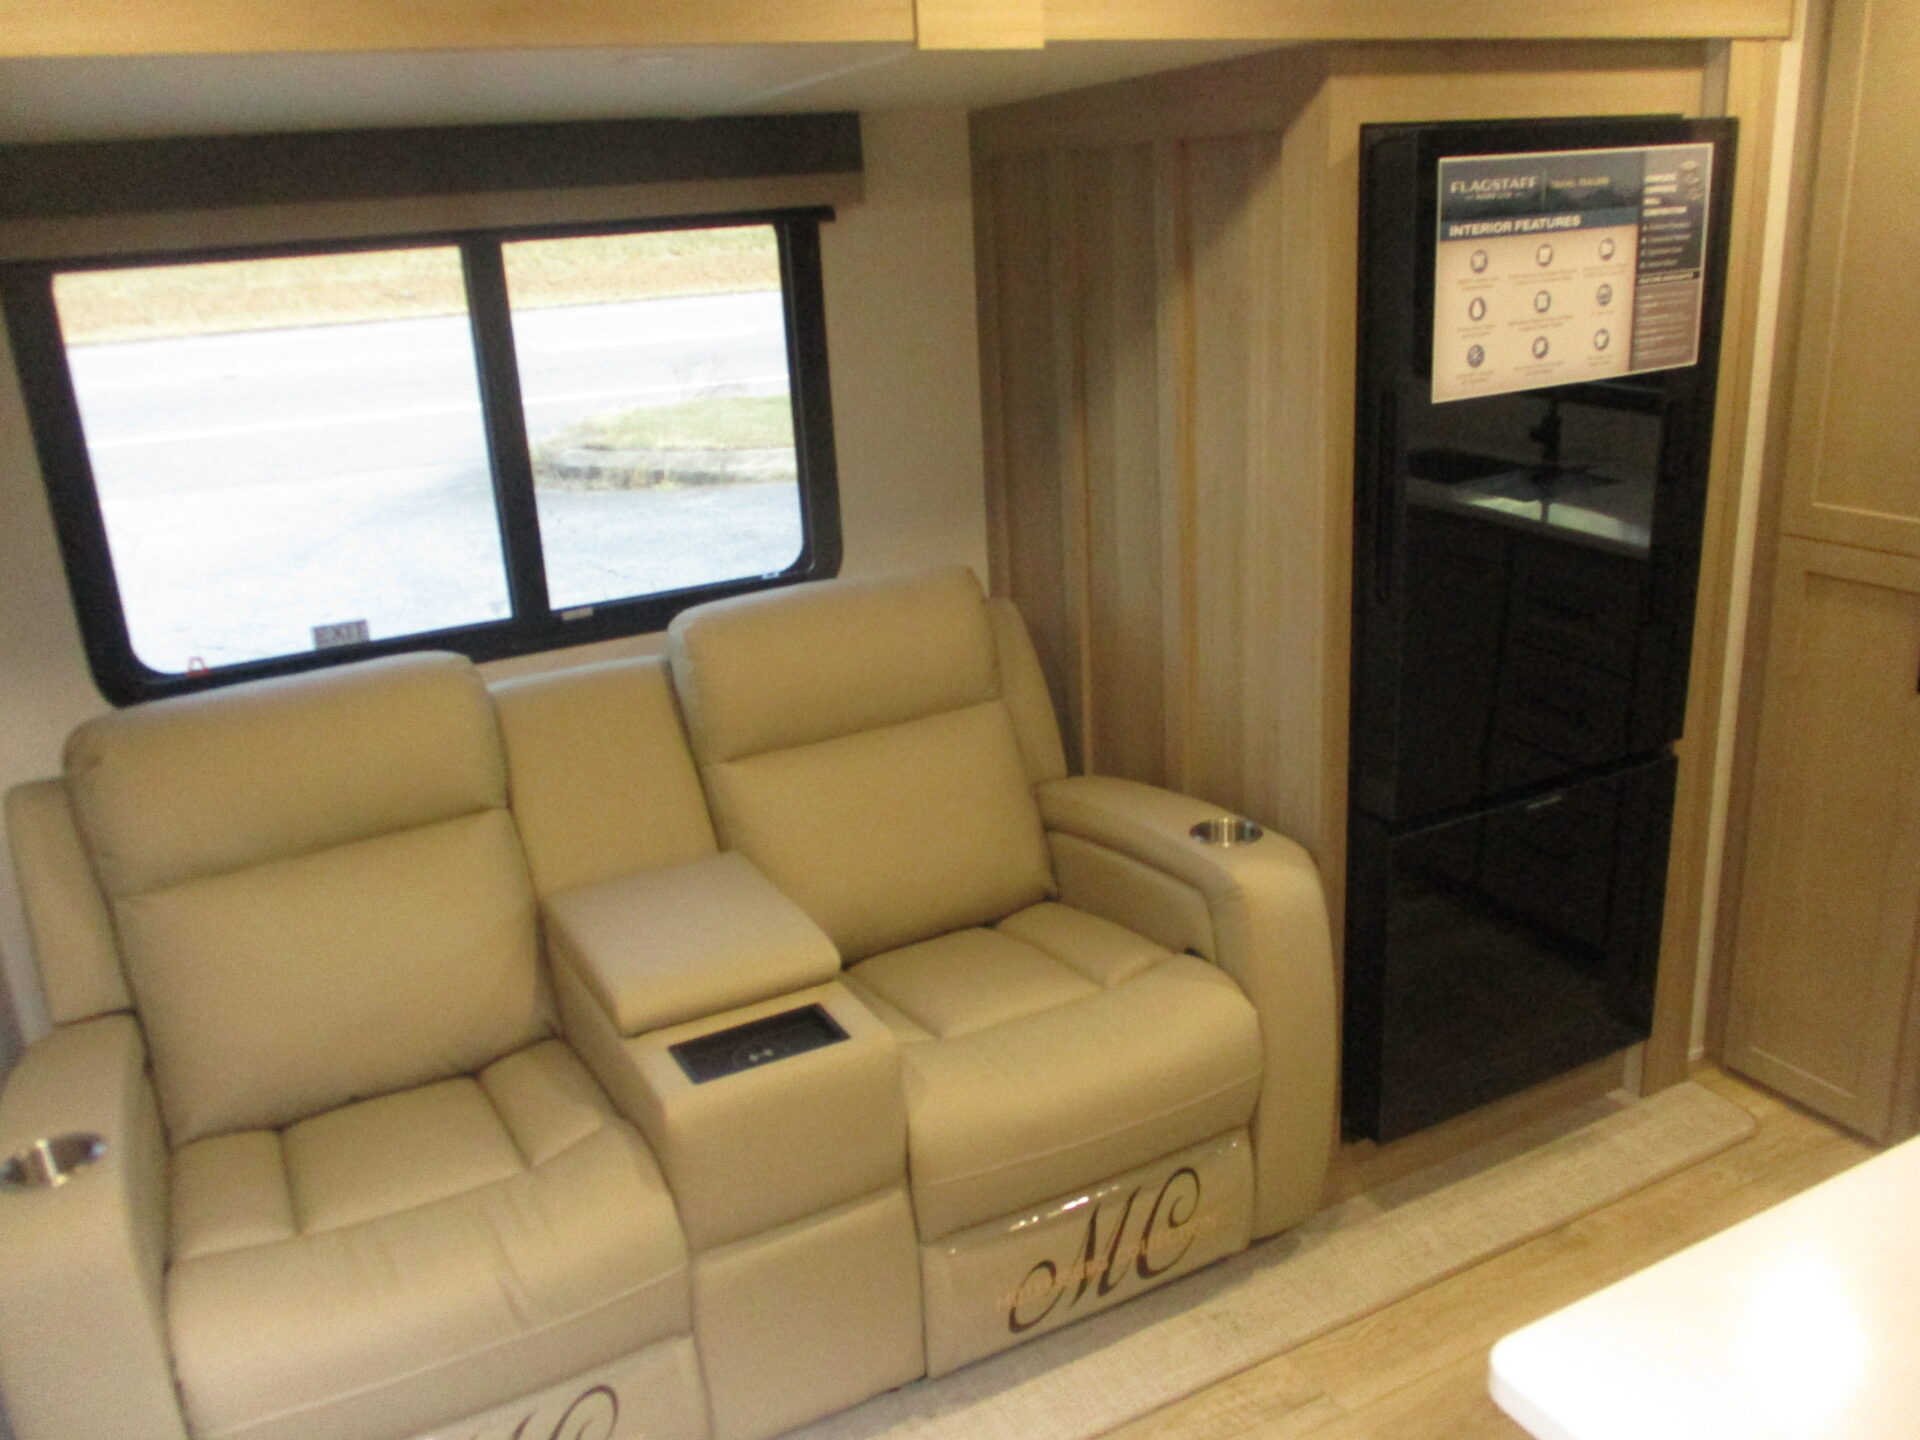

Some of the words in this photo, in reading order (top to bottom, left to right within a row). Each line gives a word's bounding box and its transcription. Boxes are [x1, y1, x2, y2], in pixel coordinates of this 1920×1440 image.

[1450, 176, 1538, 194] FLAGSTAFF
[1449, 220, 1512, 238] INTERIOR
[1514, 214, 1582, 232] FEATURES
